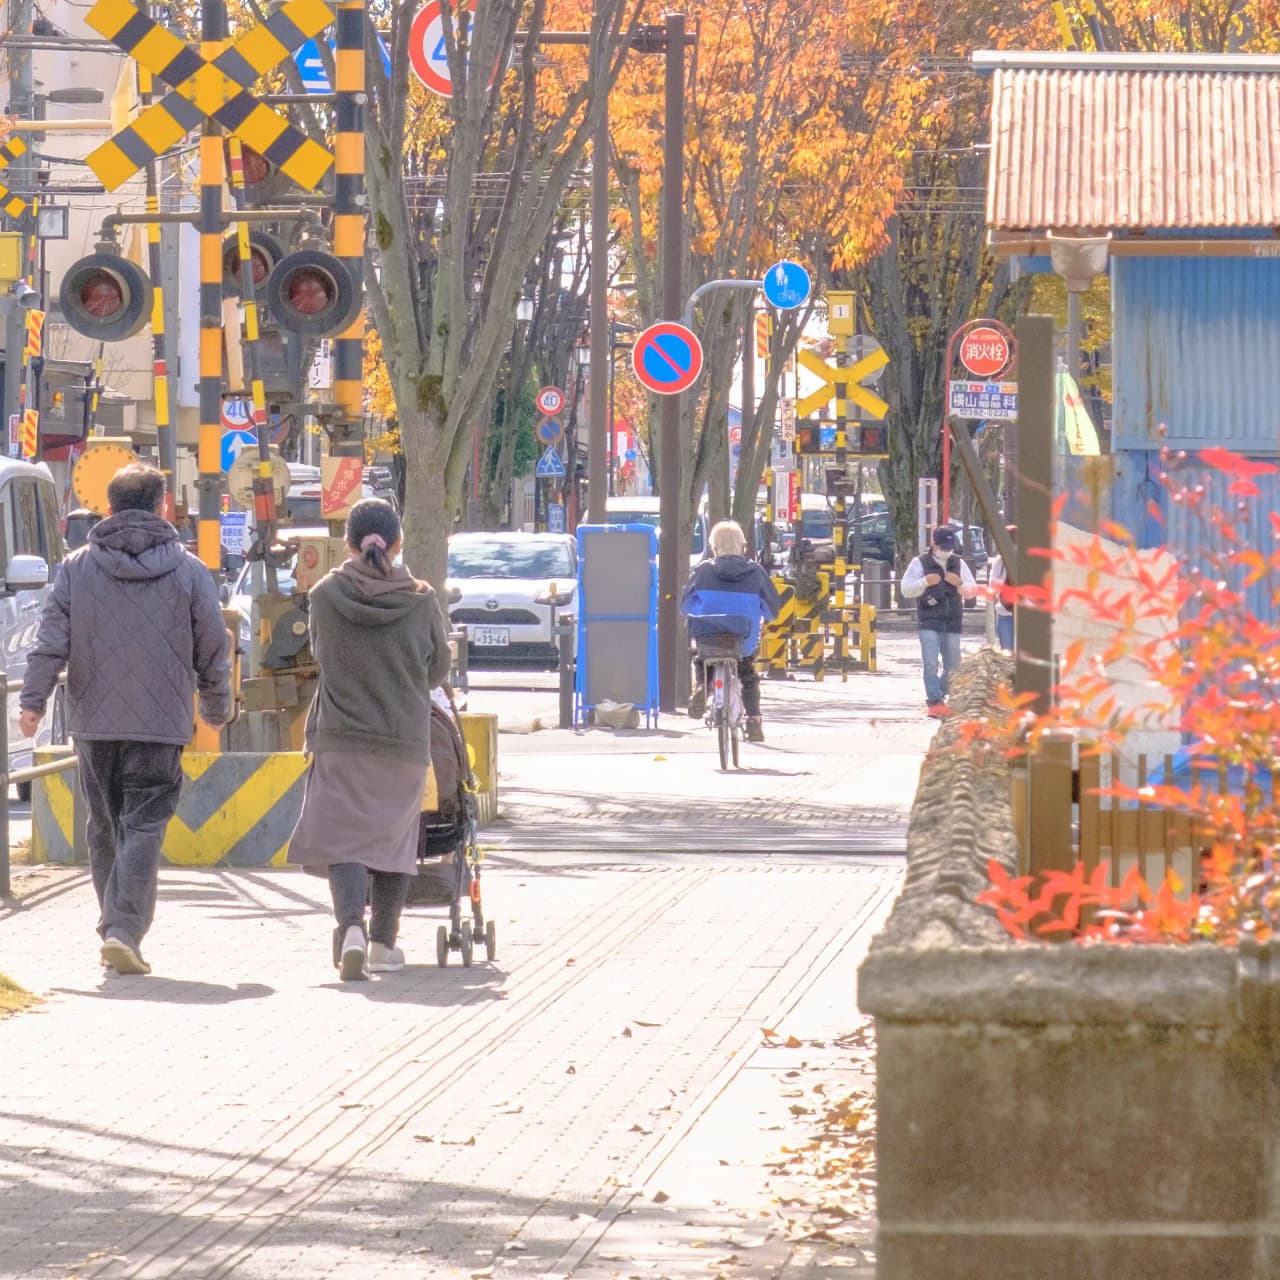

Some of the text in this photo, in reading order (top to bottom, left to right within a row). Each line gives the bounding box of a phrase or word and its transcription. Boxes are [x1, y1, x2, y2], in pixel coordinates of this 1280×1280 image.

[966, 343, 1004, 361] 消火栓
[543, 394, 558, 408] 40
[226, 402, 251, 419] 40
